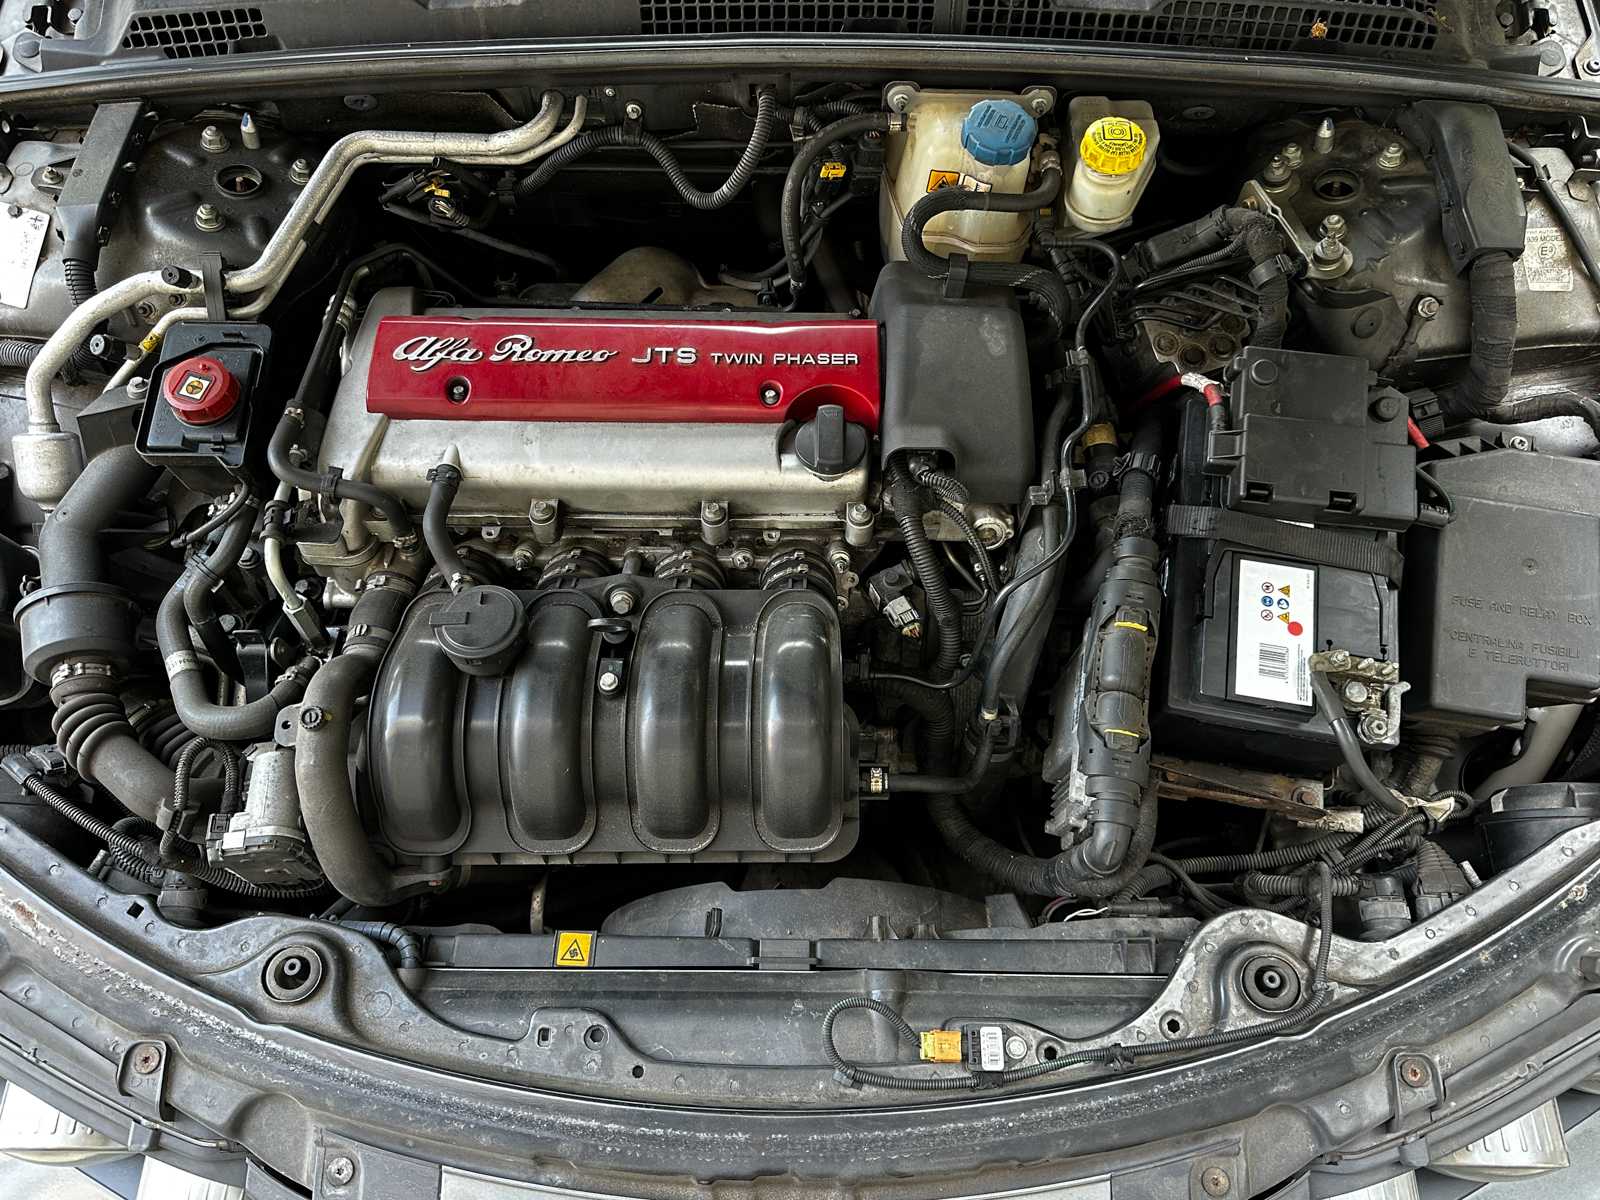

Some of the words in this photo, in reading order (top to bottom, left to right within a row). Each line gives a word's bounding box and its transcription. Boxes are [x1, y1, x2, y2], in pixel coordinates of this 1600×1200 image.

[392, 336, 483, 371] Alfa
[489, 334, 618, 362] Romeo
[631, 347, 697, 364] JTS
[710, 352, 763, 365] TWIN
[773, 353, 859, 365] PHASER
[1450, 595, 1483, 609] FUSE
[1489, 601, 1513, 614] AND
[1519, 605, 1560, 620] RELAY
[1567, 612, 1593, 626] BOX
[1450, 630, 1525, 650] CENTRALINA
[1531, 643, 1580, 659] FUSIBILI
[1483, 650, 1570, 673] TELERUTTORI
